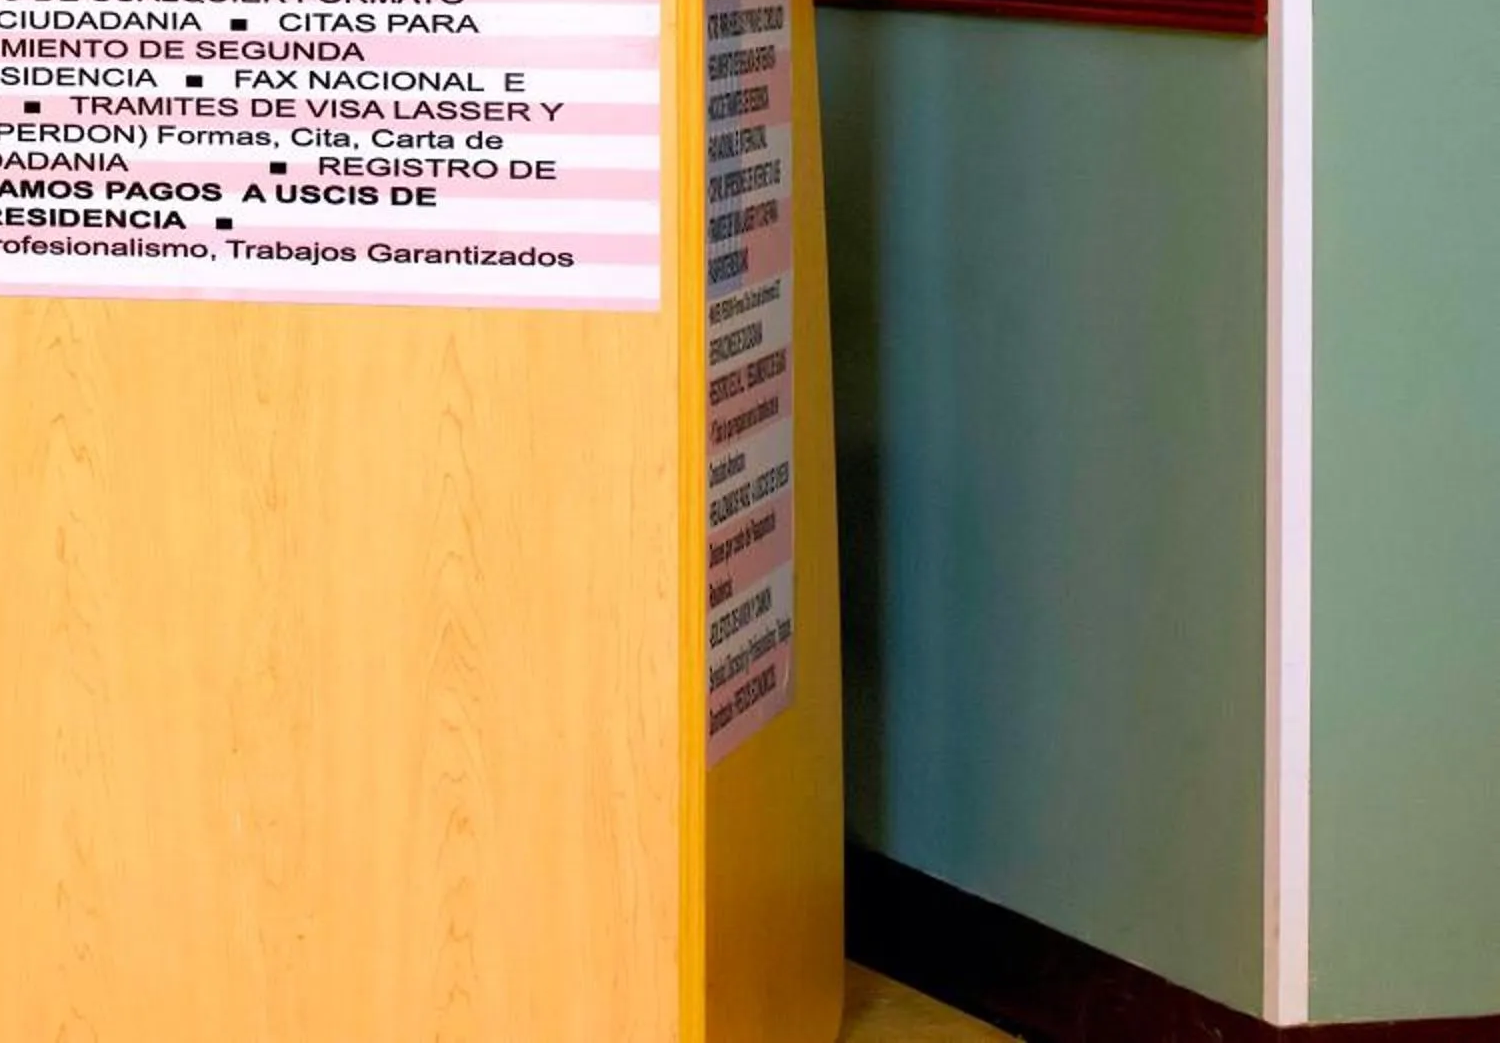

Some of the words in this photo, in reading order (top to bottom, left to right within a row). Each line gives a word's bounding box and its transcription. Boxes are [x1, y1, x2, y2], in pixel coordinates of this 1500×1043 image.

[279, 12, 377, 33] CITAS
[387, 14, 479, 34] PARA
[139, 39, 185, 60] DE
[195, 40, 365, 62] SEGUNDA
[235, 69, 298, 90] FAX
[309, 70, 485, 92] NACIONAL
[504, 72, 525, 92] E
[69, 95, 239, 118] TRAMITES
[251, 98, 297, 118] DE
[305, 99, 385, 120] VISA
[393, 100, 531, 122] LASSER
[540, 102, 564, 122] Y
[157, 124, 280, 149] Formas,
[291, 127, 359, 150] Cita,
[371, 128, 455, 150] Carta
[465, 130, 504, 150] de
[318, 156, 499, 180] REGISTRO
[509, 160, 557, 180] DE
[105, 180, 223, 202] PAGOS
[241, 183, 267, 204] A
[275, 184, 379, 206] USCIS
[390, 186, 437, 207] DE
[225, 239, 357, 266] Trabajos
[367, 242, 575, 268] Garantizados
